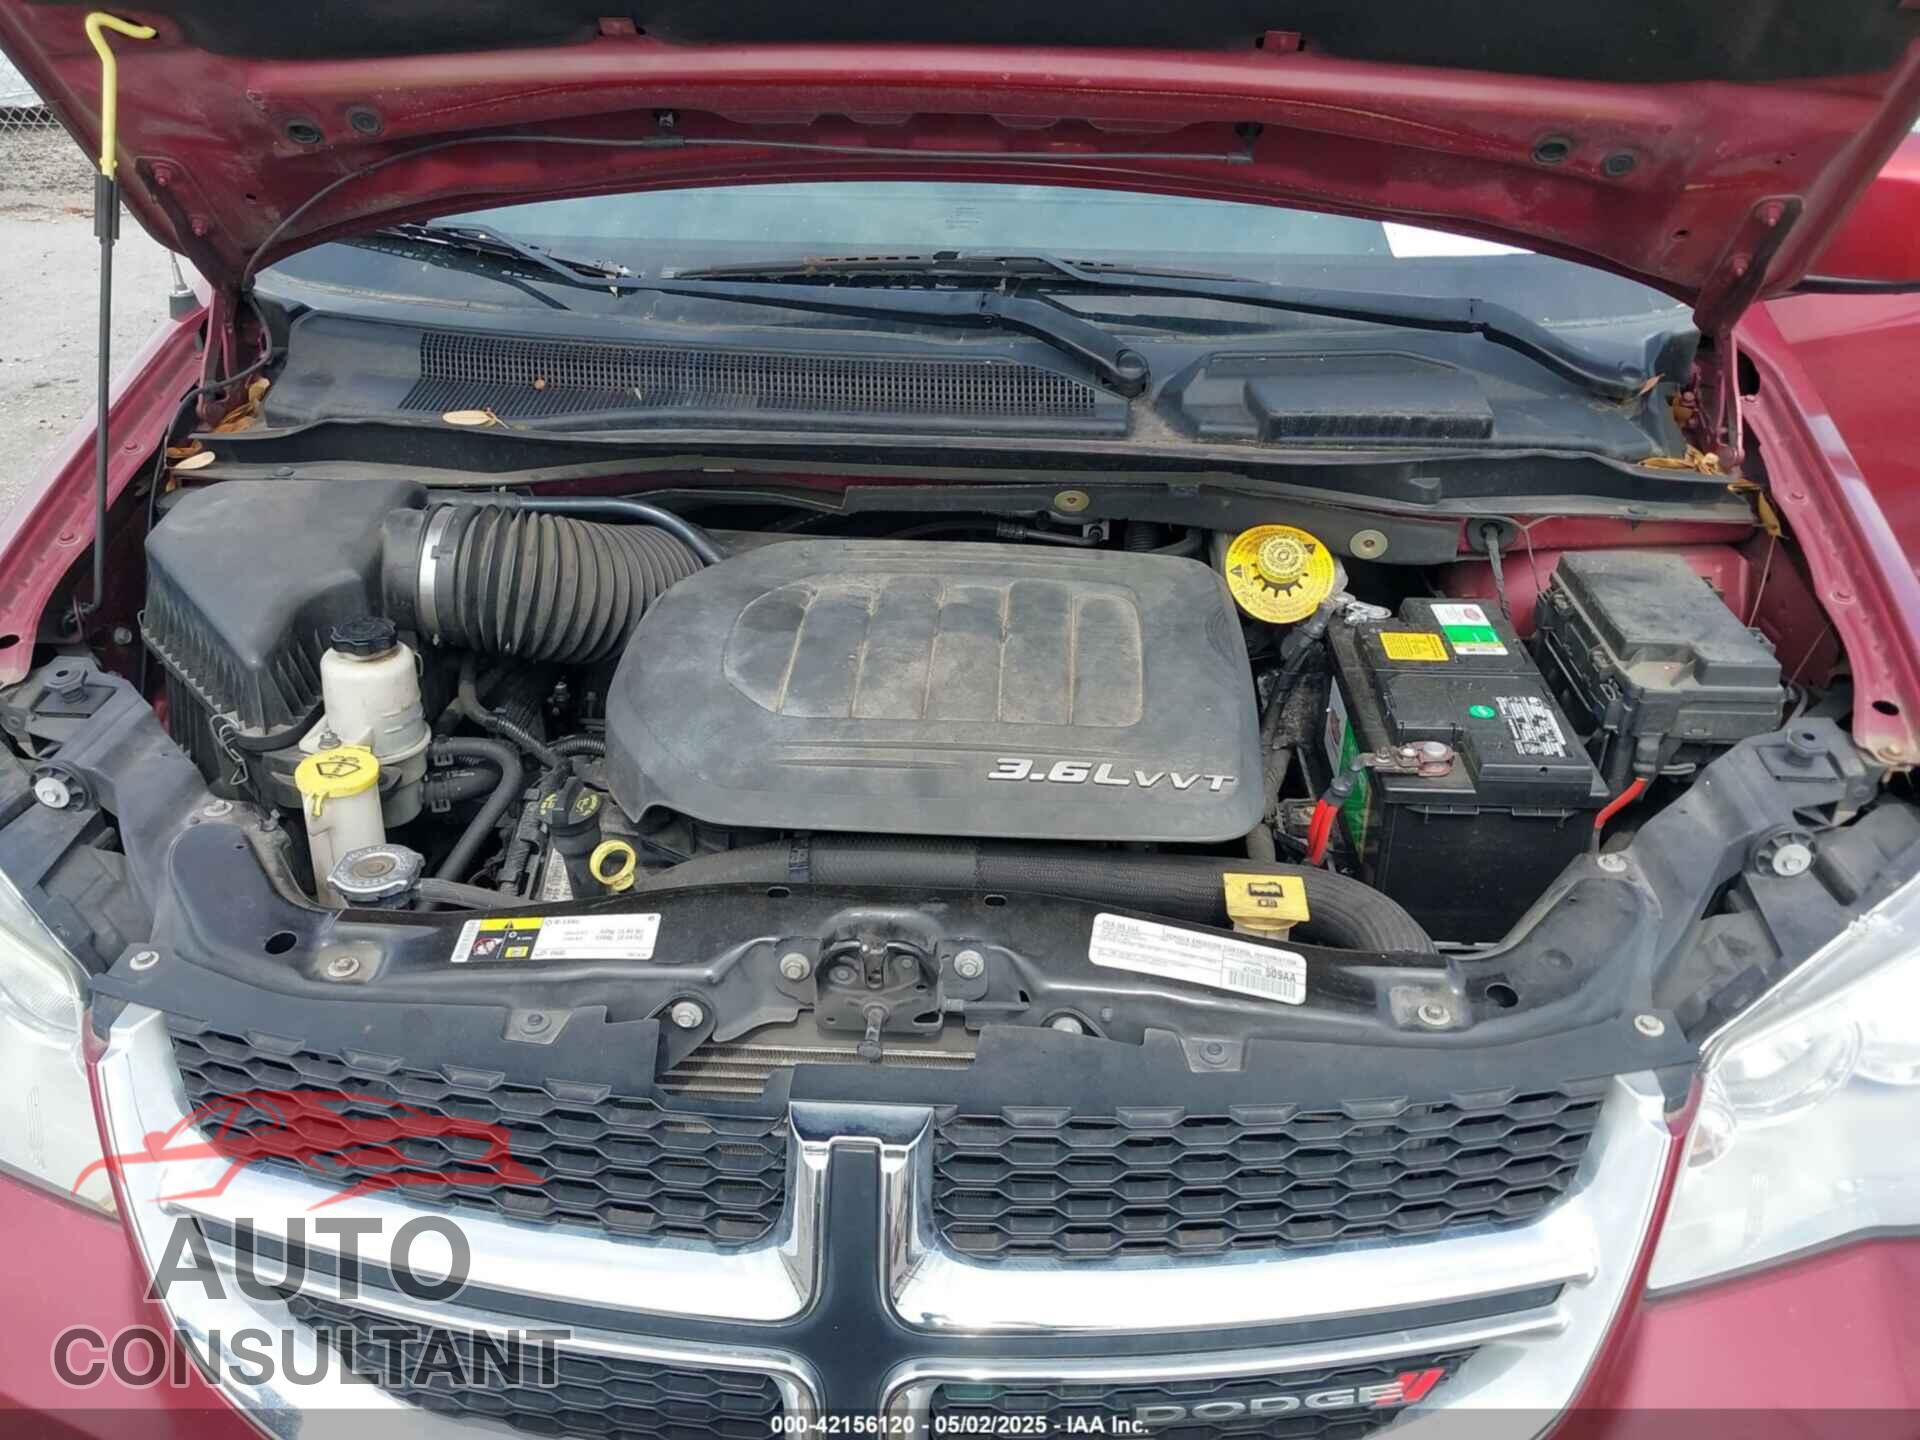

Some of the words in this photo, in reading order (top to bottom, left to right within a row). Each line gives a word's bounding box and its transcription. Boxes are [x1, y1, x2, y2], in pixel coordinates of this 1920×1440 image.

[988, 758, 1131, 787] 3.6L
[1133, 770, 1236, 791] VVT
[1136, 1382, 1404, 1423] DODGE
